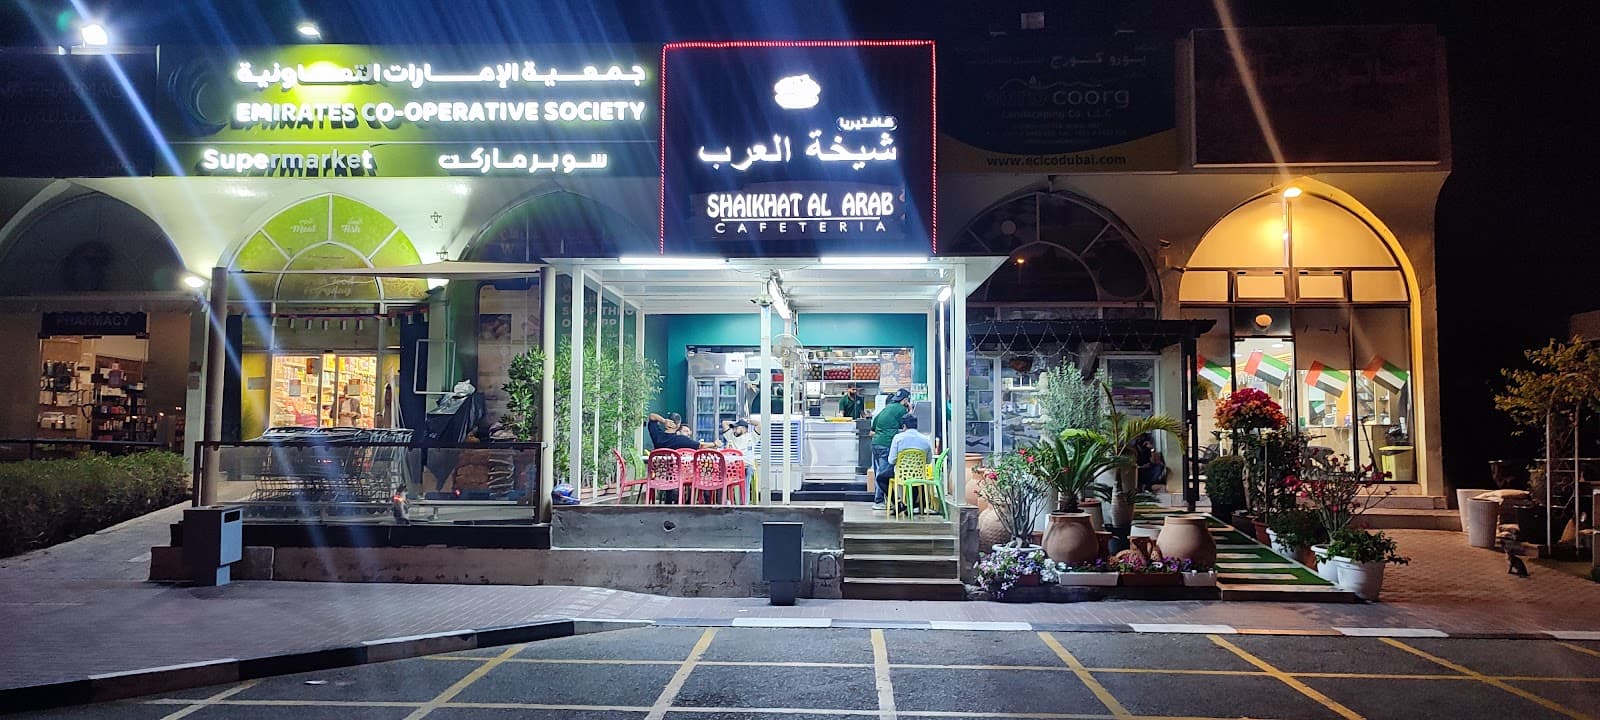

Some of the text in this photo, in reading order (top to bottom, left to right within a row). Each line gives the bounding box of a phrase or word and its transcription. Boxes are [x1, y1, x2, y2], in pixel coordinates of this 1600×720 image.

[383, 62, 519, 88] الإمارات
[522, 61, 646, 87] جمعية
[1053, 90, 1129, 108] coorg
[236, 101, 645, 121] EMIRATES CO-OPERATIVE SOCIETY
[203, 149, 373, 172] Supermarket
[698, 129, 897, 171] شيخة العرب
[707, 192, 894, 218] SHAIKHAT AL ARAB
[715, 221, 886, 233] CAFETERIA
[562, 306, 595, 315] SOP
